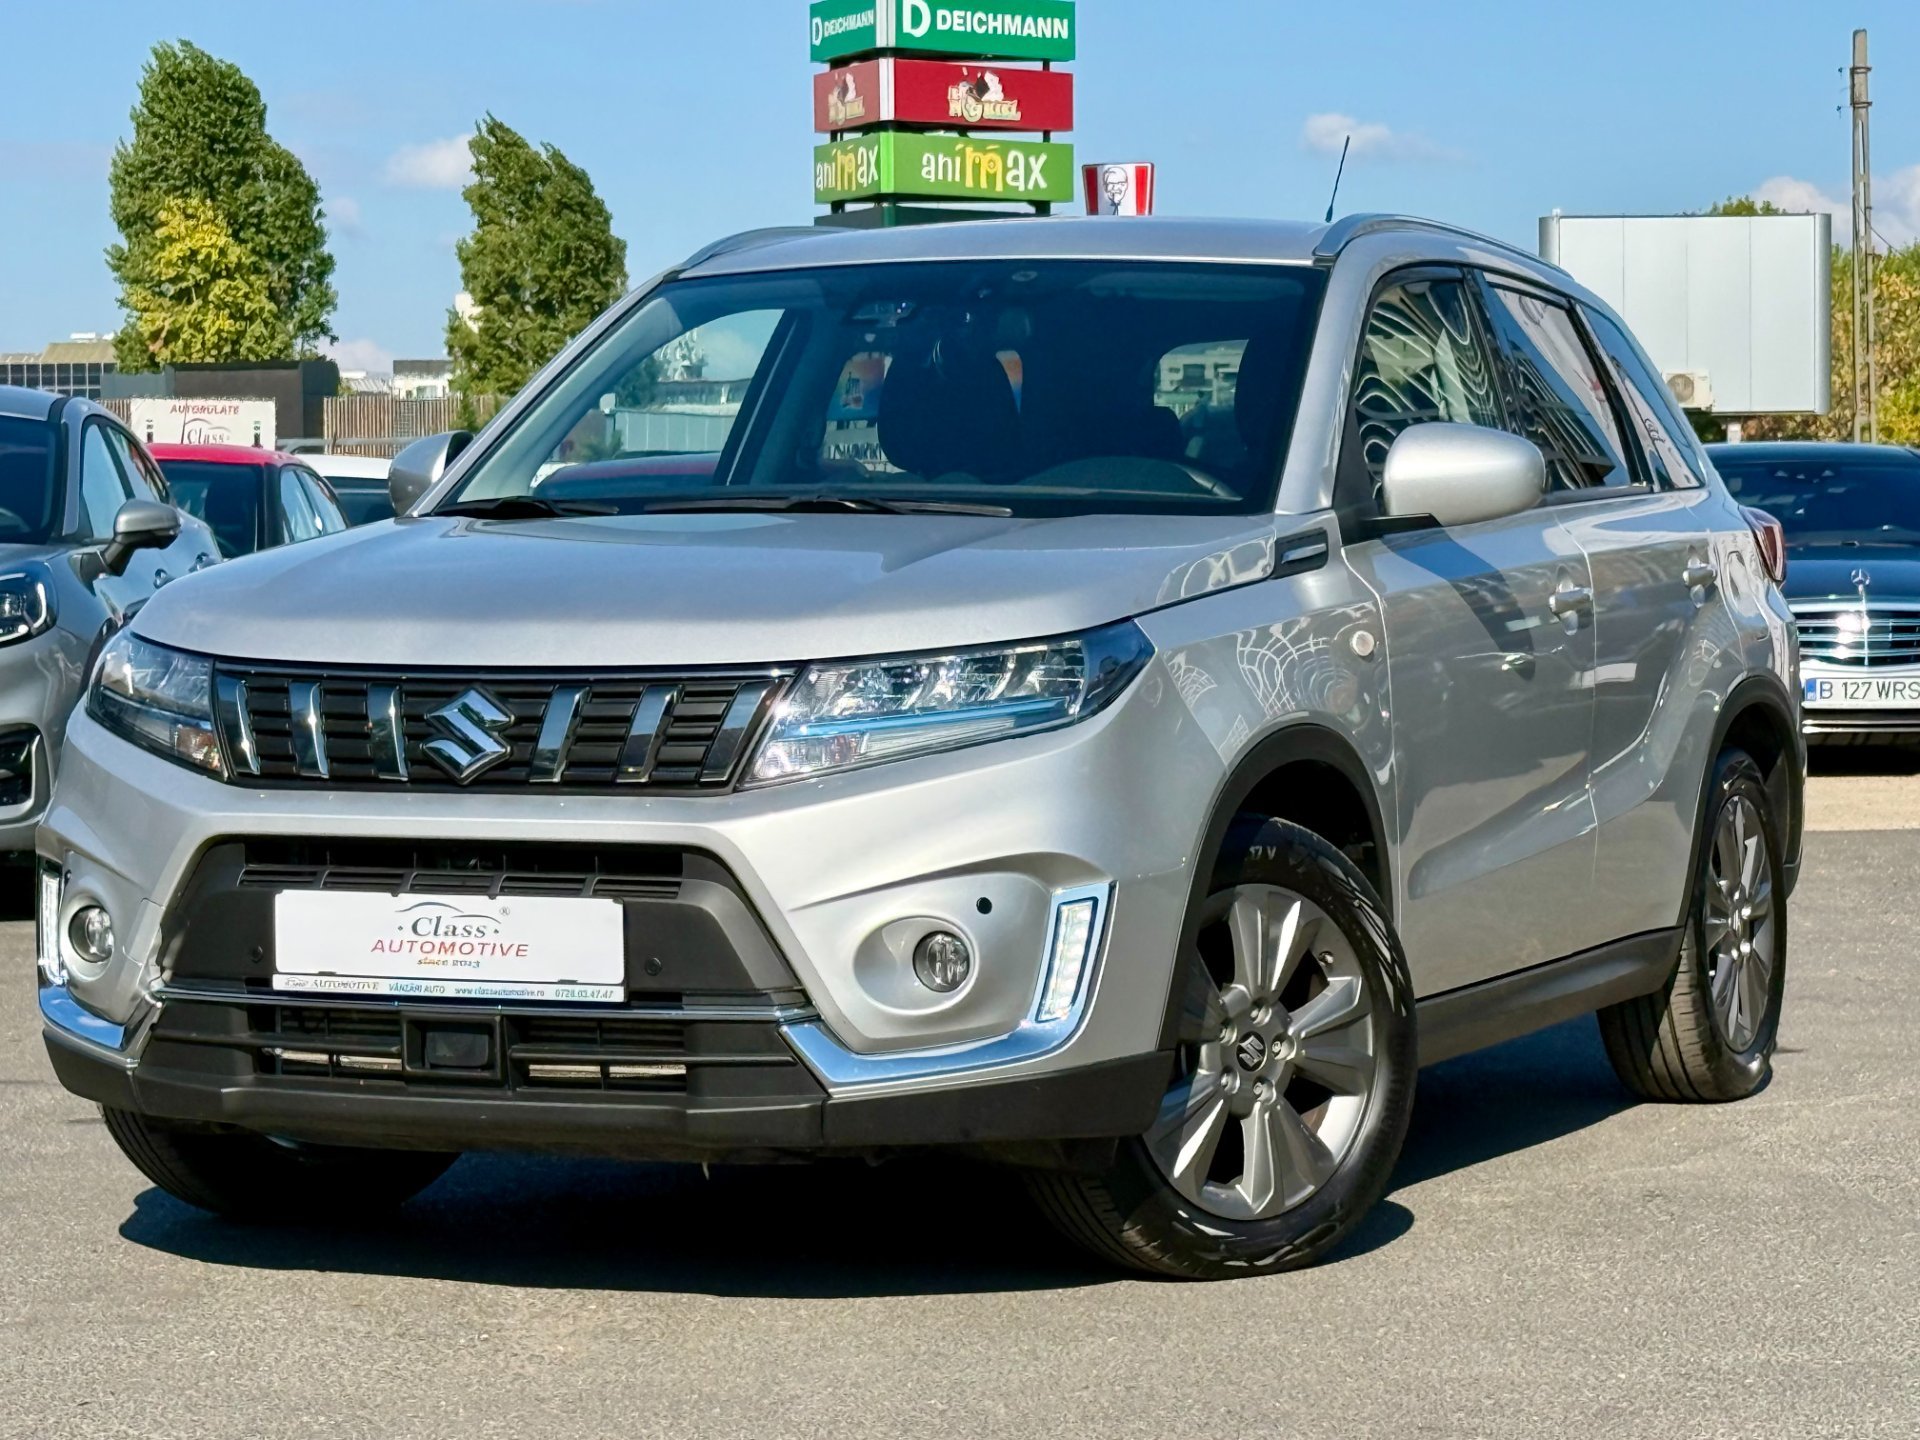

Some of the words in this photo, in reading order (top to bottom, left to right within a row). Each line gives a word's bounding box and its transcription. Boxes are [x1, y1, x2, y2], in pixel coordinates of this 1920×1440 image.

[824, 9, 874, 38] DEICHMANN
[936, 9, 1069, 39] DEICHMANN
[1819, 681, 1833, 699] B
[1842, 681, 1872, 699] 127
[1876, 681, 1920, 699] WRS
[411, 915, 487, 938] Class
[371, 939, 529, 957] AUTOMOTIVE
